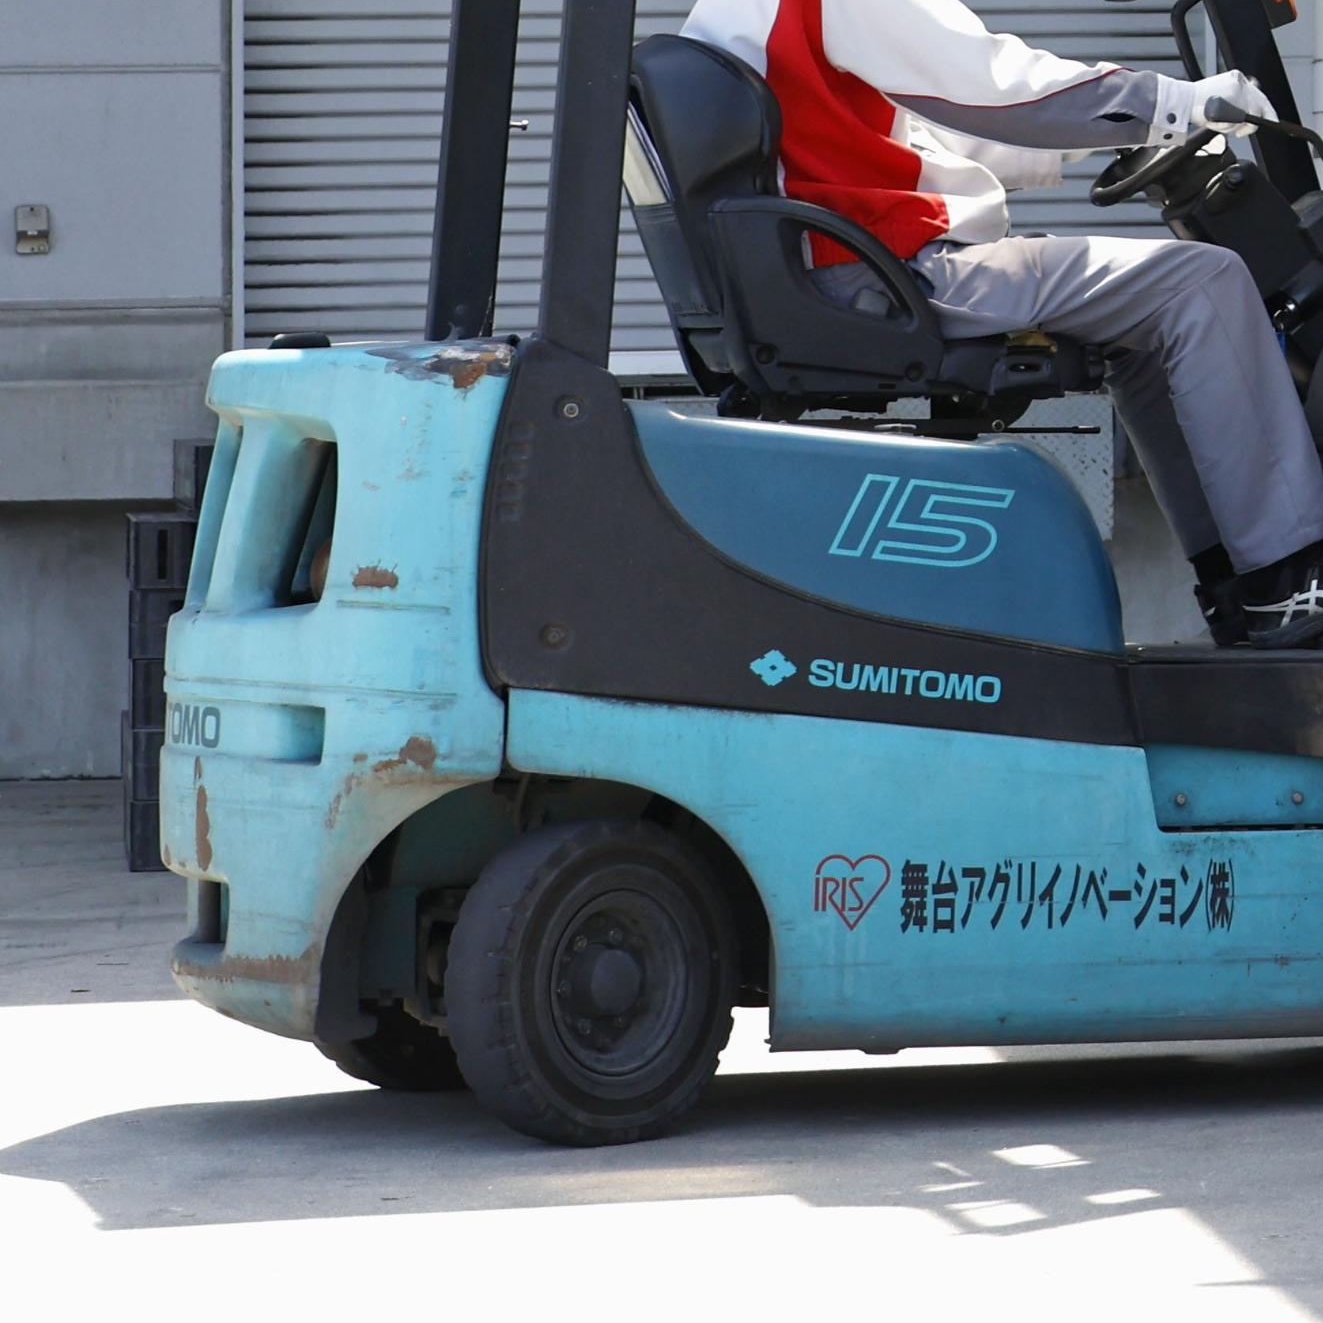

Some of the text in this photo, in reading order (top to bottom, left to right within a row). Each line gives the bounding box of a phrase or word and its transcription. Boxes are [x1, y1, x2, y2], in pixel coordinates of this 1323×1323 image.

[828, 473, 1016, 568] 15
[808, 658, 1002, 704] SUMITOMO
[813, 875, 865, 913] IRIS
